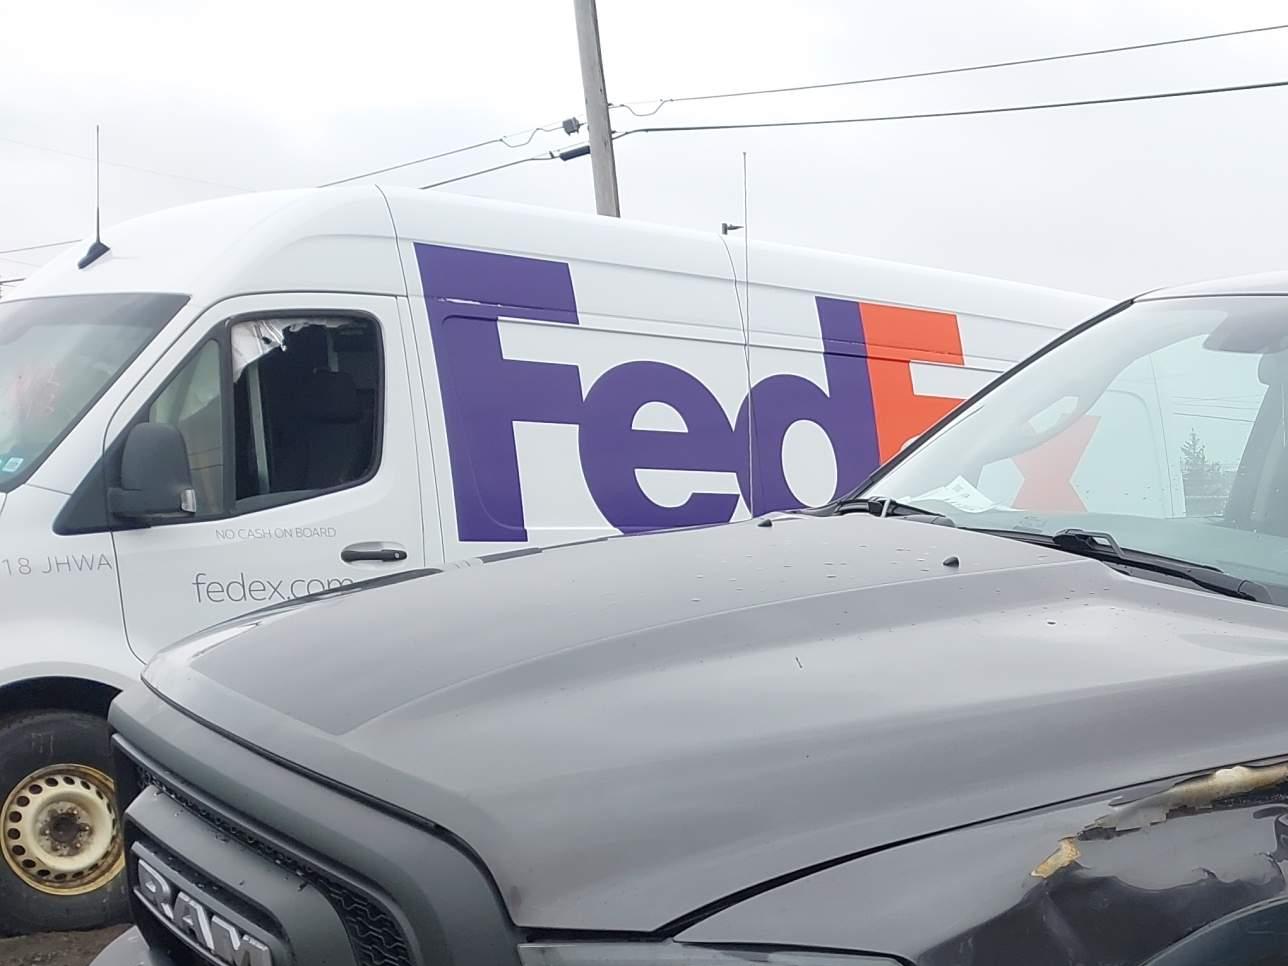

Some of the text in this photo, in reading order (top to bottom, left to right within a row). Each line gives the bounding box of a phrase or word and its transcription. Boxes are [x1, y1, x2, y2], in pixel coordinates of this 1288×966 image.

[216, 527, 337, 540] NO CASH ON BOARD
[41, 553, 113, 574] JHWA
